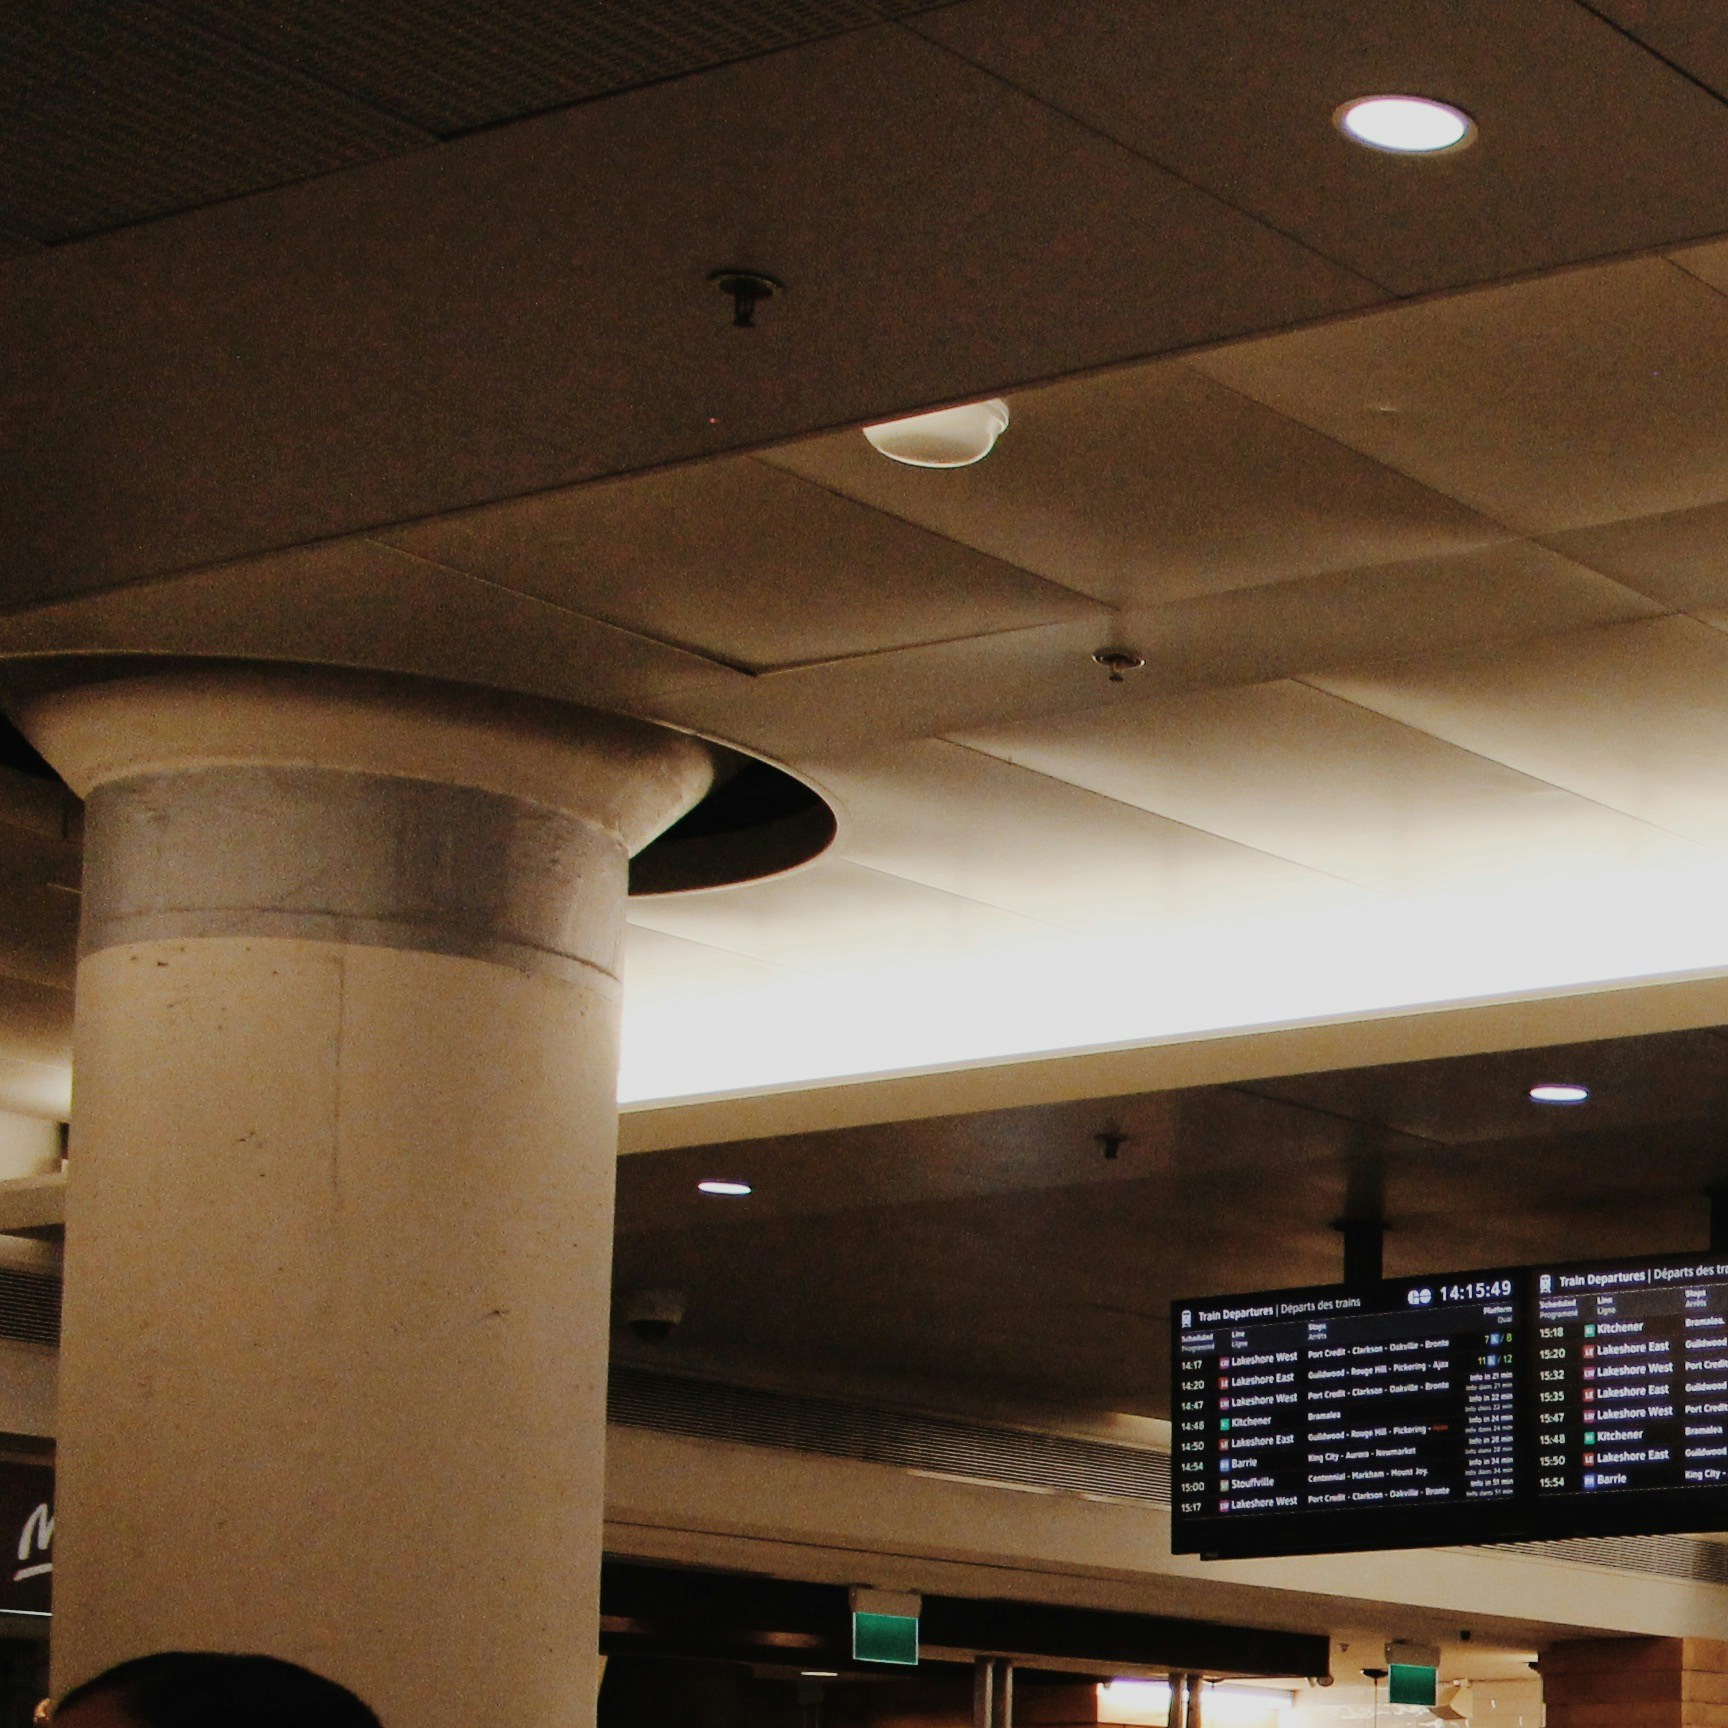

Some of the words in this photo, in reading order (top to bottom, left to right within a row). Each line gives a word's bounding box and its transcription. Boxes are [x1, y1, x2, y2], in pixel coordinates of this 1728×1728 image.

[1560, 1275, 1585, 1287] Train
[1587, 1271, 1645, 1286] Departures
[1654, 1265, 1693, 1281] Départs
[1696, 1265, 1714, 1276] des
[1440, 1280, 1511, 1301] 14:15:49
[1199, 1311, 1221, 1322] Train
[1222, 1306, 1273, 1321] Departures
[1281, 1301, 1315, 1315] Départs
[1317, 1300, 1333, 1310] des
[1335, 1298, 1360, 1308] trains
[1540, 1327, 1564, 1338] 15:18
[1597, 1322, 1643, 1334] Kitchener
[1597, 1343, 1646, 1356] Lakeshore
[1649, 1341, 1670, 1352] East
[1685, 1338, 1727, 1349] Guildwood
[1308, 1351, 1323, 1359] Port
[1324, 1348, 1346, 1357] Credit
[1352, 1346, 1383, 1355] Clarkson
[1390, 1342, 1419, 1352] Oakville
[1540, 1348, 1565, 1359] 15:20
[1182, 1360, 1202, 1370] 14:17
[1232, 1354, 1273, 1367] Lakeshore
[1276, 1352, 1298, 1362] West
[1685, 1362, 1702, 1370] Port
[1704, 1359, 1728, 1369] Credit
[1308, 1369, 1345, 1380] Guildwood
[1393, 1363, 1426, 1372] Pickering
[1540, 1370, 1564, 1381] 15:32
[1597, 1364, 1646, 1378] Lakeshore
[1648, 1363, 1673, 1373] West
[1232, 1375, 1274, 1387] Lakeshore
[1276, 1373, 1294, 1382] East
[1182, 1381, 1204, 1391] 14:20
[1308, 1392, 1323, 1400] Port
[1352, 1388, 1383, 1397] Clarkson
[1540, 1391, 1564, 1402] 15:35
[1597, 1386, 1646, 1400] Lakeshore
[1649, 1384, 1670, 1395] East
[1181, 1401, 1203, 1411] 14:47
[1232, 1395, 1274, 1408] Lakeshore
[1275, 1393, 1298, 1403] West
[1540, 1413, 1564, 1423] 15:47
[1597, 1408, 1646, 1420] Lakeshore
[1648, 1406, 1673, 1416] West
[1232, 1417, 1272, 1428] Kitchener
[1393, 1426, 1426, 1435] Pickering
[1597, 1430, 1643, 1442] Kitchener
[1685, 1426, 1723, 1436] Bramalea
[1232, 1436, 1274, 1448] Lakeshore
[1276, 1434, 1294, 1444] East
[1540, 1434, 1565, 1445] 15:48
[1181, 1442, 1204, 1451] 14:50
[1308, 1454, 1323, 1463] King
[1325, 1452, 1339, 1461] City
[1346, 1450, 1369, 1459] Aurora
[1540, 1456, 1565, 1466] 15:50
[1597, 1451, 1646, 1464] Lakeshore
[1649, 1449, 1669, 1460] East
[1181, 1462, 1203, 1472] 14:54
[1232, 1458, 1257, 1469] Barrie
[1391, 1468, 1413, 1477] Mount
[1685, 1471, 1702, 1480] King
[1705, 1469, 1720, 1479] City
[1232, 1477, 1274, 1489] Stouffville
[1540, 1477, 1564, 1487] 15:54
[1597, 1474, 1627, 1485] Barrie
[1181, 1482, 1204, 1492] 15:00
[1308, 1495, 1323, 1503] Port
[1352, 1492, 1383, 1500] Clarkson
[1390, 1488, 1419, 1498] Oakville
[1181, 1503, 1201, 1512] 15:17
[1232, 1498, 1274, 1510] Lakeshore
[1275, 1496, 1298, 1506] West
